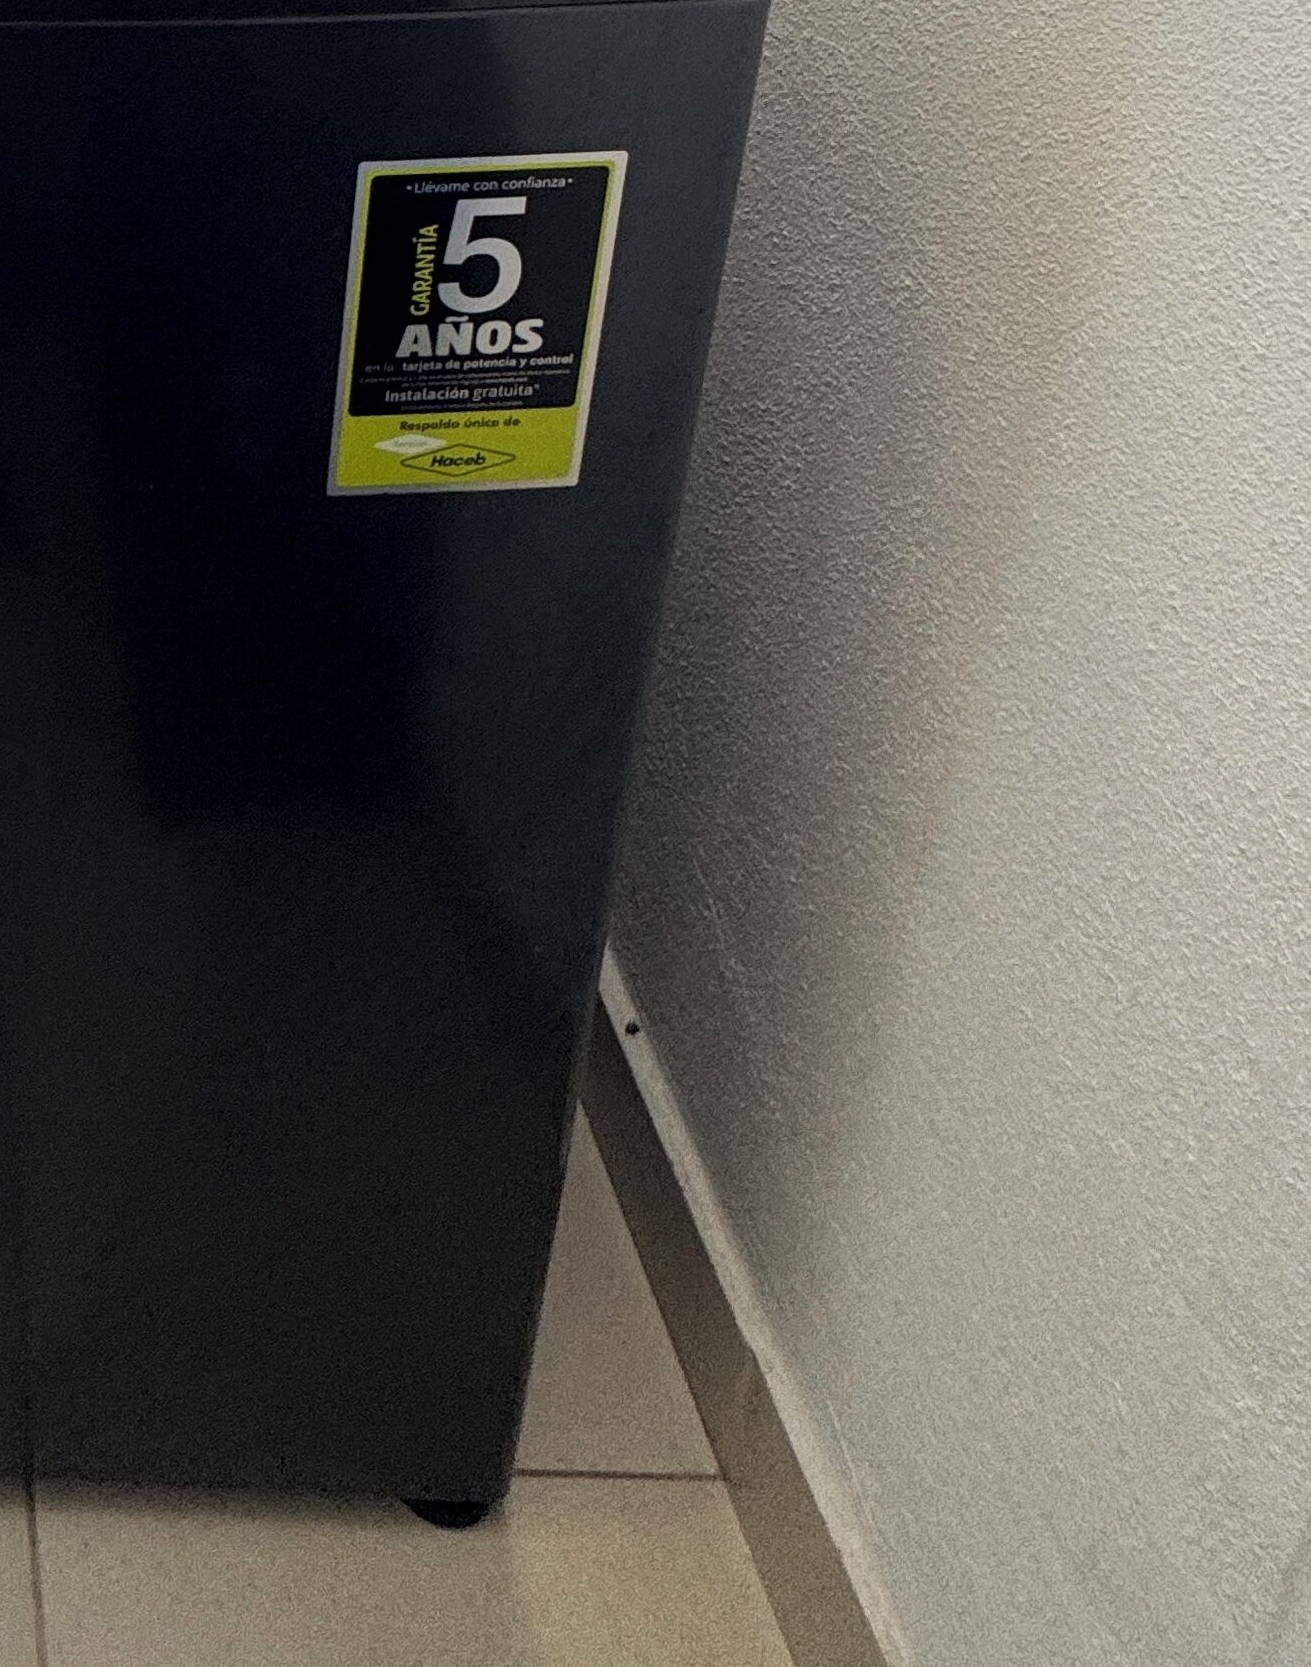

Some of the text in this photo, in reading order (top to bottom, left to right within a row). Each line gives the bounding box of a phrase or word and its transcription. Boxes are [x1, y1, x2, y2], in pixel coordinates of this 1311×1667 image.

[415, 176, 566, 194] Llévame con confianza
[437, 195, 528, 314] 5
[409, 224, 439, 317] GARANTÍA
[395, 315, 544, 358] AÑOS
[402, 360, 443, 373] tarjeta
[445, 359, 461, 370] de
[463, 356, 517, 370] potencia
[519, 358, 528, 368] y
[529, 353, 574, 366] control
[385, 386, 469, 403] Instalación
[399, 419, 460, 432] Respaldo
[503, 416, 521, 427] de
[429, 451, 487, 468] Haceb
